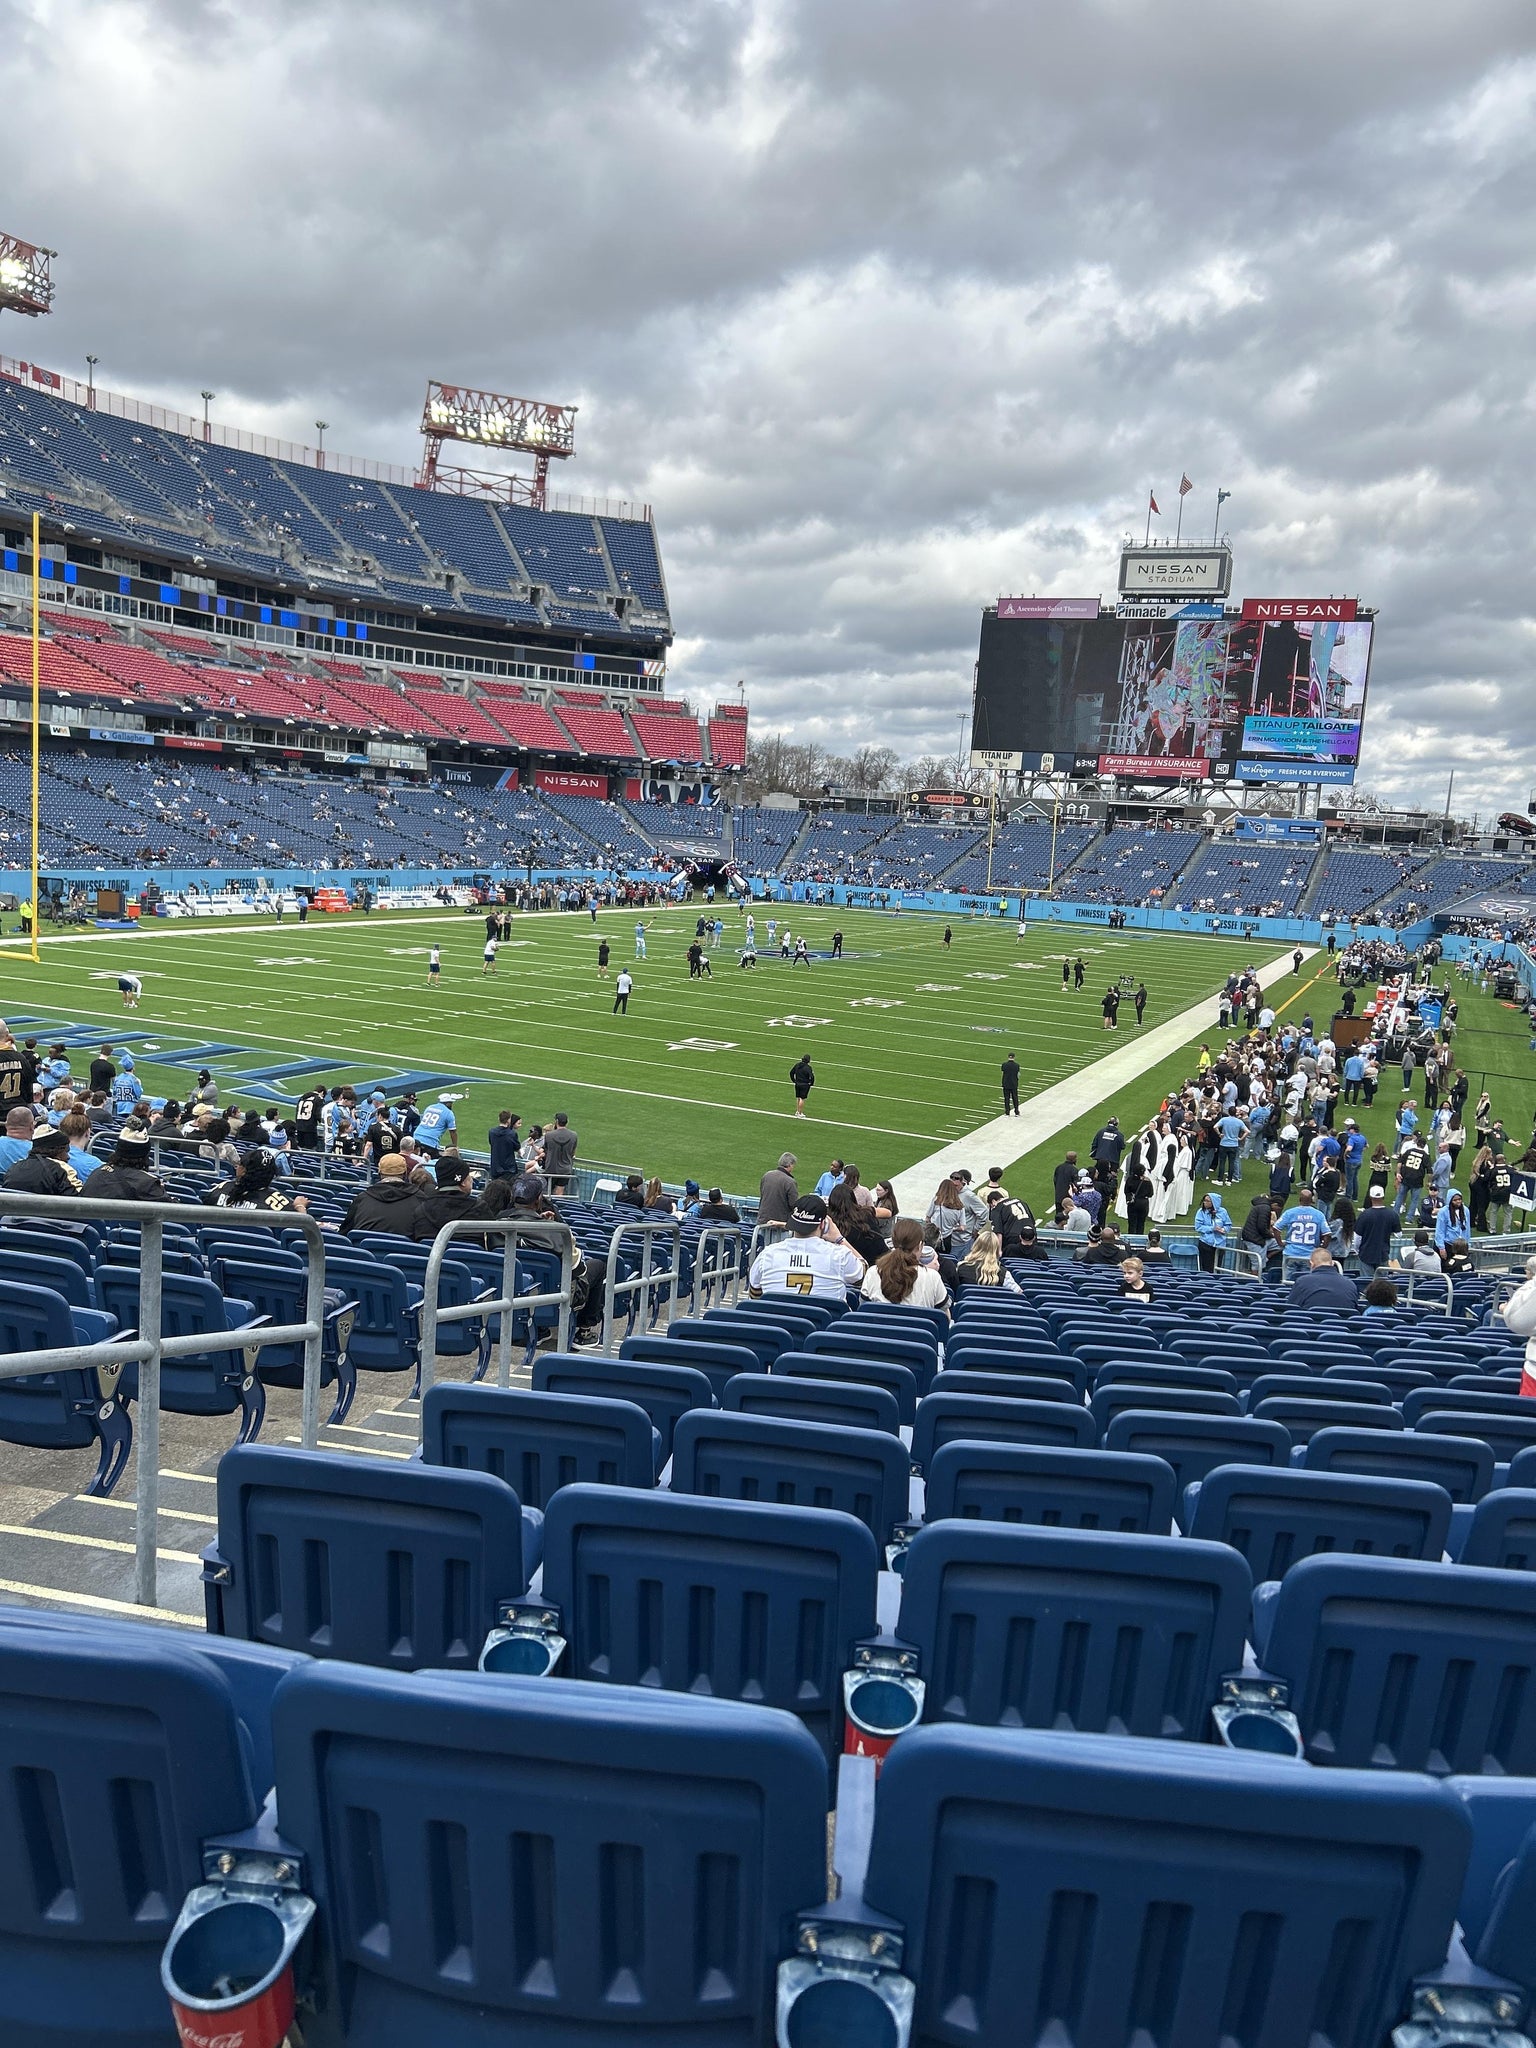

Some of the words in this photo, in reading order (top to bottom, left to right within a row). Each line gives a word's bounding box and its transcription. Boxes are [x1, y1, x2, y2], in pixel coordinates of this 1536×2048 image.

[1138, 565, 1207, 574] NISSAN
[1117, 605, 1166, 618] Pinnacle
[1257, 605, 1341, 616] NISSAN
[1253, 721, 1282, 729] TITAN
[1285, 721, 1300, 729] UP
[1302, 722, 1354, 731] TAILGATE
[112, 731, 146, 742] Gallagher
[1003, 752, 1013, 760] UP
[1154, 760, 1202, 768] INSURANCE
[1251, 764, 1275, 777] Kroger
[445, 769, 471, 783] TITANS
[544, 776, 599, 788] NISSAN
[225, 879, 257, 889] TEESSEE
[1075, 909, 1106, 919] TENNESSEE
[1205, 919, 1238, 929] TEESSEE
[297, 1101, 313, 1120] 13
[423, 1112, 440, 1127] 99
[1406, 1156, 1422, 1169] 28
[1496, 1174, 1510, 1187] 99
[1517, 1181, 1528, 1197] A
[265, 1192, 289, 1211] 25
[1291, 1222, 1317, 1244] 22
[790, 1255, 811, 1268] HILL
[786, 1273, 813, 1295] 7
